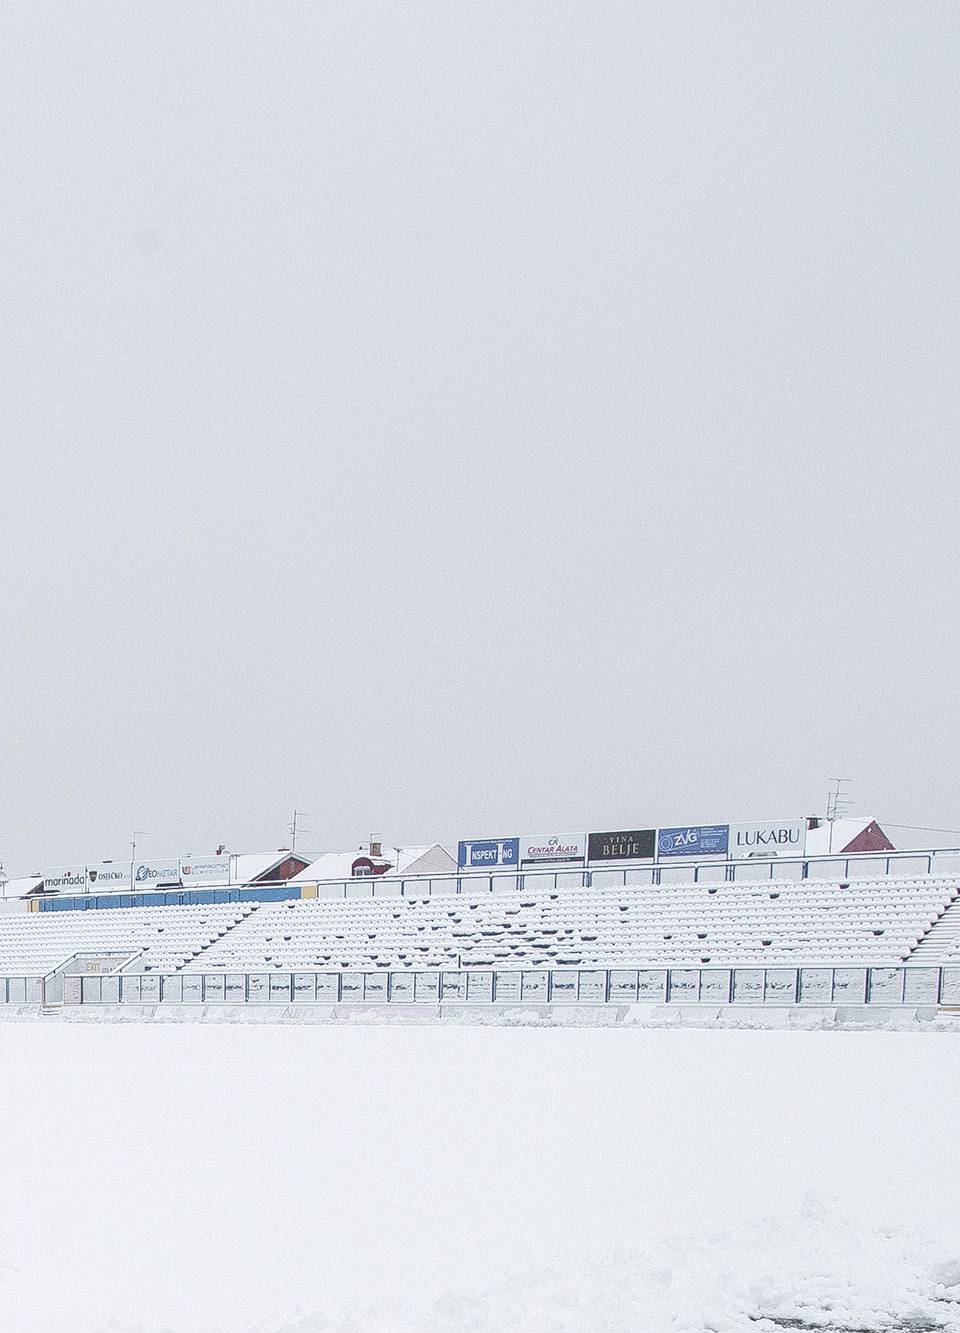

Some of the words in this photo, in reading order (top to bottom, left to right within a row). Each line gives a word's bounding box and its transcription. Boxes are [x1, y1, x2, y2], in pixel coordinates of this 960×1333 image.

[609, 835, 634, 844] VINA
[737, 829, 800, 846] LUKABU
[527, 846, 555, 854] CENTAR
[555, 845, 578, 853] ALATA
[603, 843, 640, 857] BELJE
[44, 871, 85, 887] marinada
